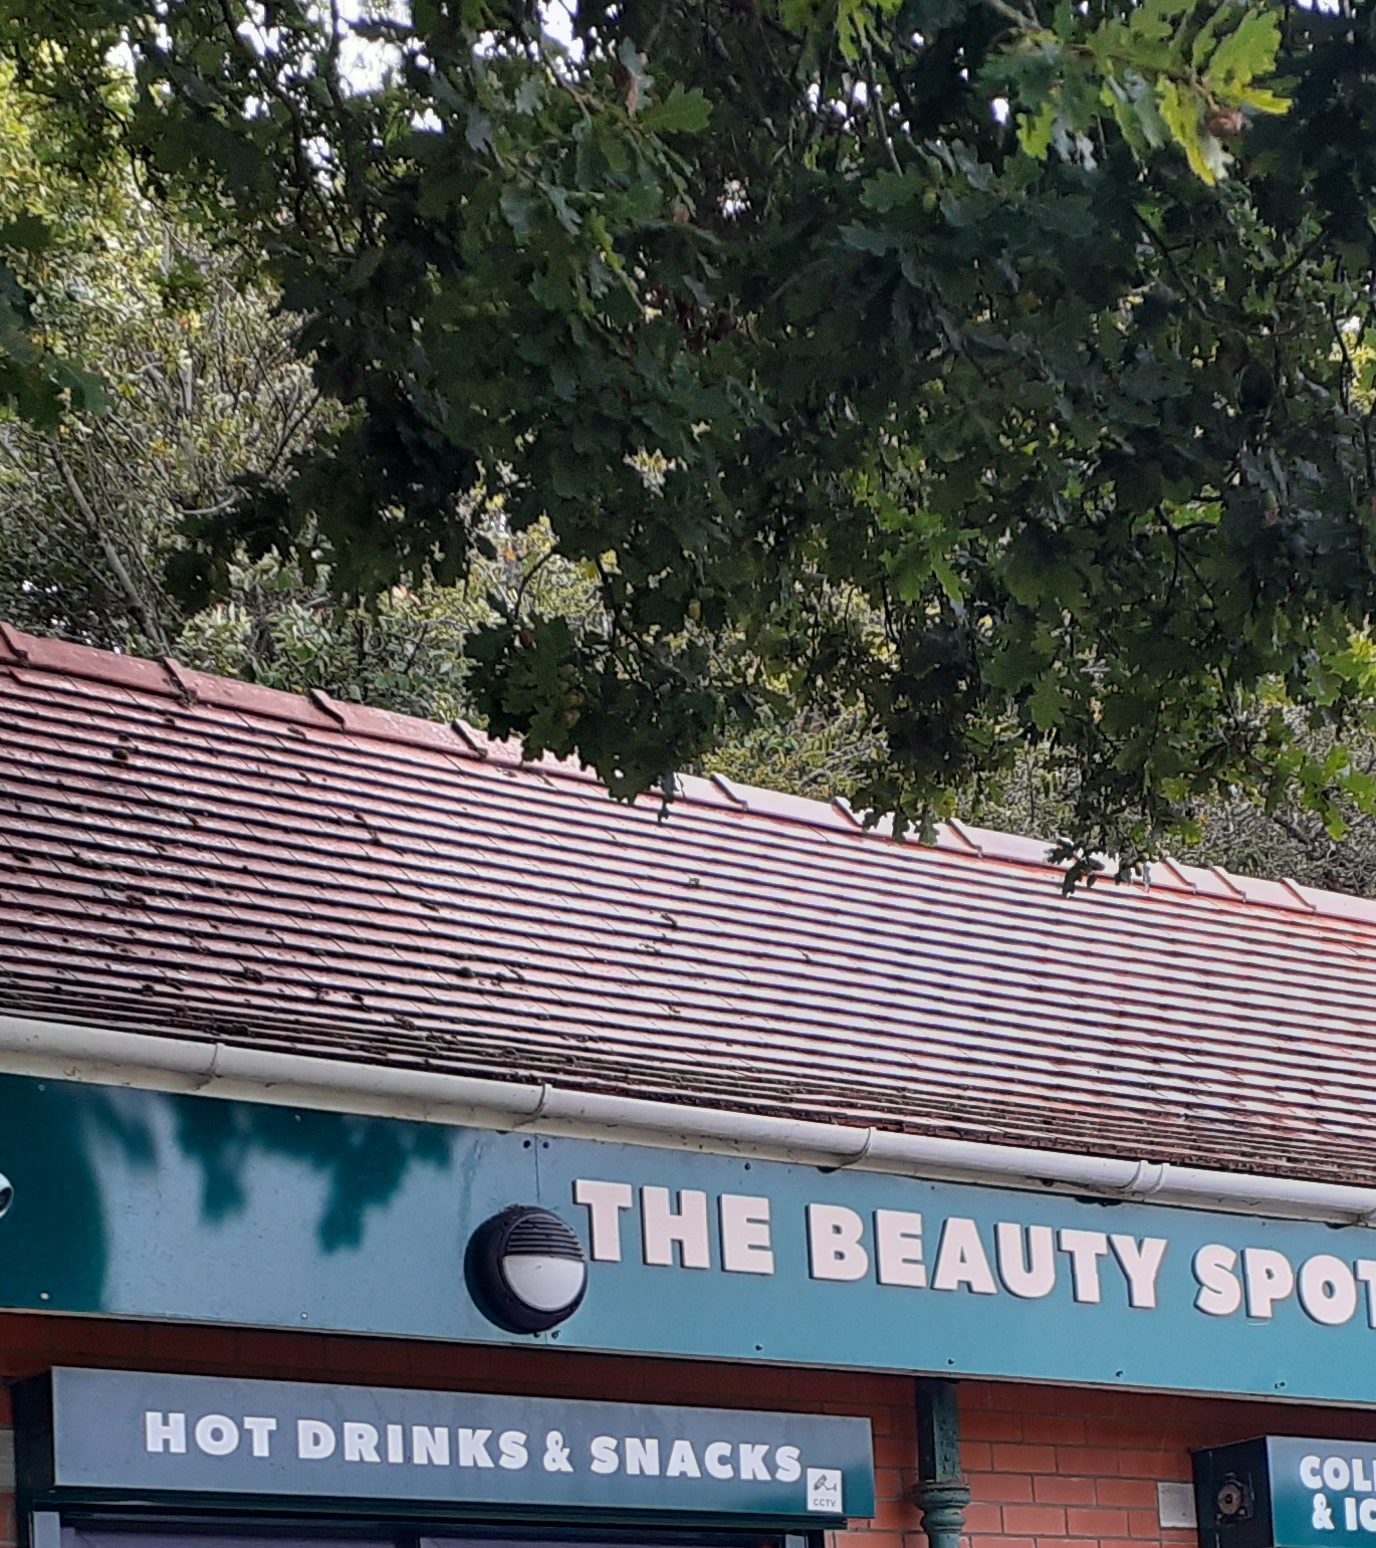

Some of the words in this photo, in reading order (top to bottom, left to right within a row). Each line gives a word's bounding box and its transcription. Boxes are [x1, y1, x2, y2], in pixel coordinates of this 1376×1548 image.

[574, 1180, 775, 1275] THE
[807, 1203, 1167, 1308] BEAUTY
[145, 1411, 276, 1457] HOT
[297, 1419, 529, 1471] DRINKS
[542, 1431, 575, 1473] &
[590, 1436, 802, 1483] SNACKS
[813, 1498, 837, 1507] CCTV
[1312, 1493, 1334, 1530] &
